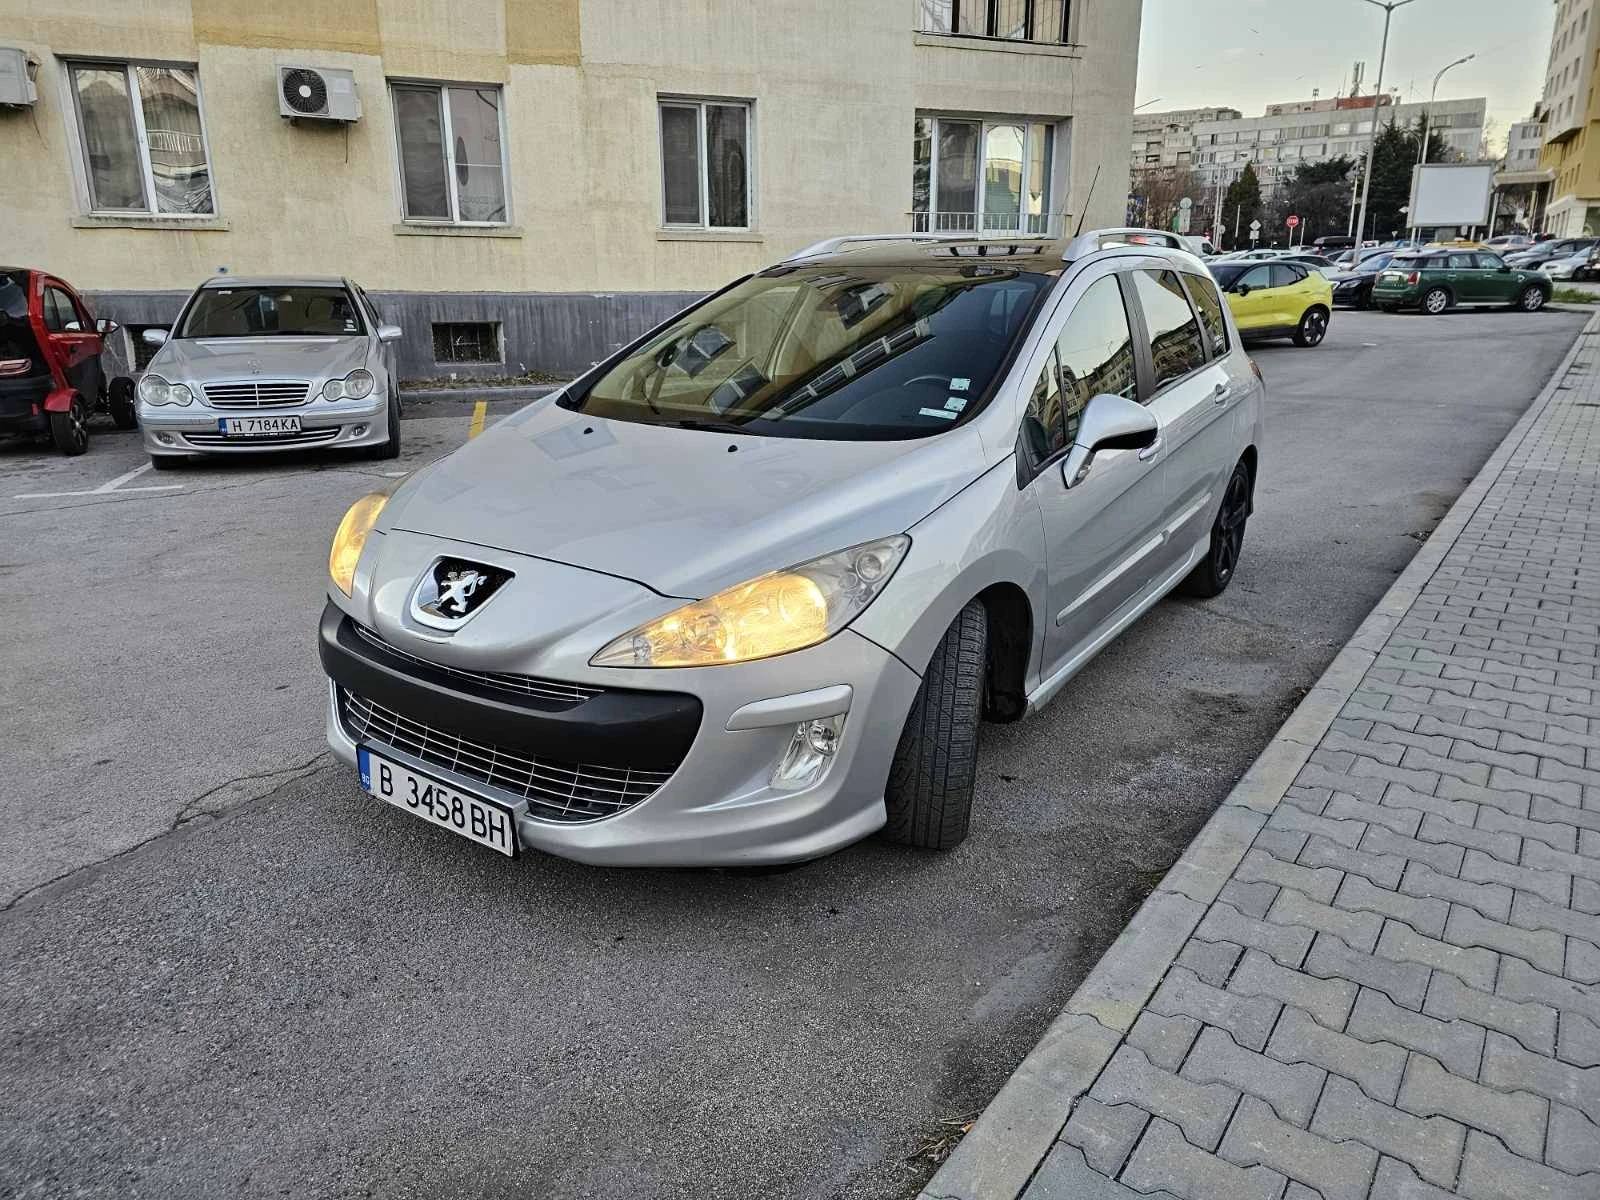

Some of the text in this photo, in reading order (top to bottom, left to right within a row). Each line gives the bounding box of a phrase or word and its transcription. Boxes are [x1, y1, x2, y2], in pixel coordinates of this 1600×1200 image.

[232, 421, 242, 432] H
[380, 763, 505, 848] B 3458 BH
